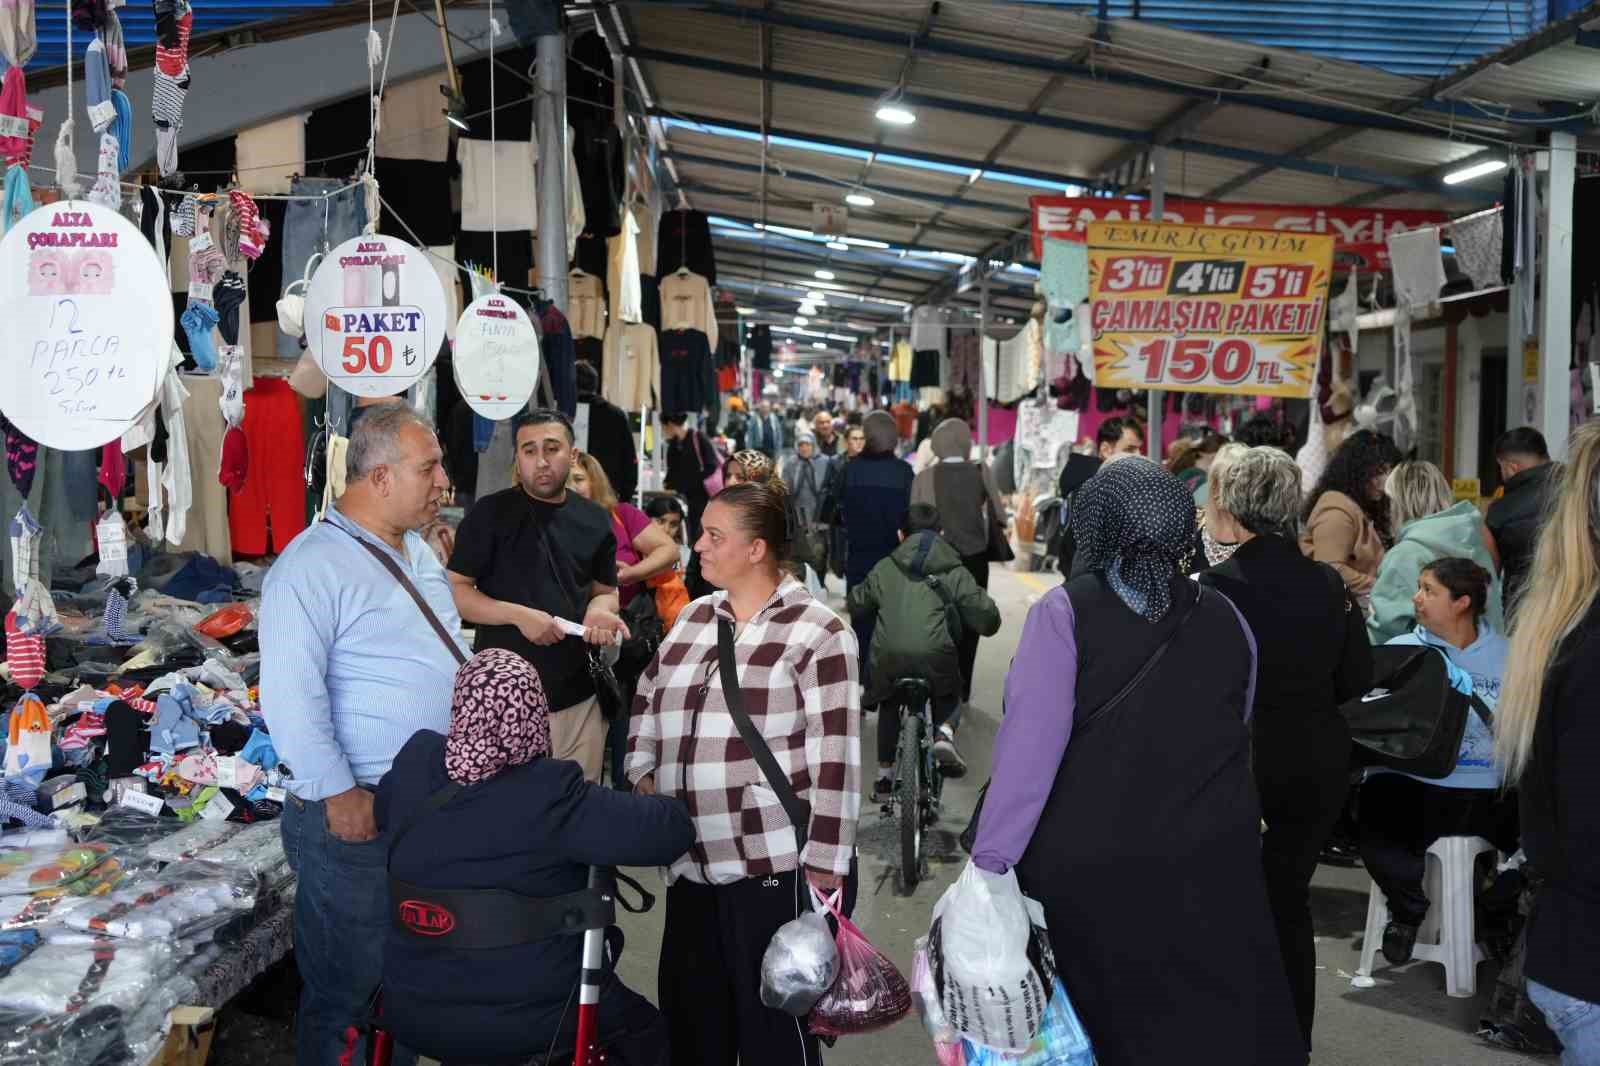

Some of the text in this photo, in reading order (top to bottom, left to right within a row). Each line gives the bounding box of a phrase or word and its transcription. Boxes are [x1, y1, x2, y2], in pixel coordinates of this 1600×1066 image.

[51, 212, 93, 227] ALYA
[27, 232, 118, 250] ÇORAPLARI
[1104, 226, 1308, 252] EMİR İÇ GİYİM
[1107, 258, 1303, 298] 3'lü 4'lü 5'li
[49, 298, 83, 334] 12
[343, 312, 421, 333] PAKET
[1091, 298, 1322, 340] ÇAMAŞIR PAKETİ
[341, 335, 393, 374] 50
[1138, 338, 1284, 384] 150 TL
[43, 366, 99, 396] 250
